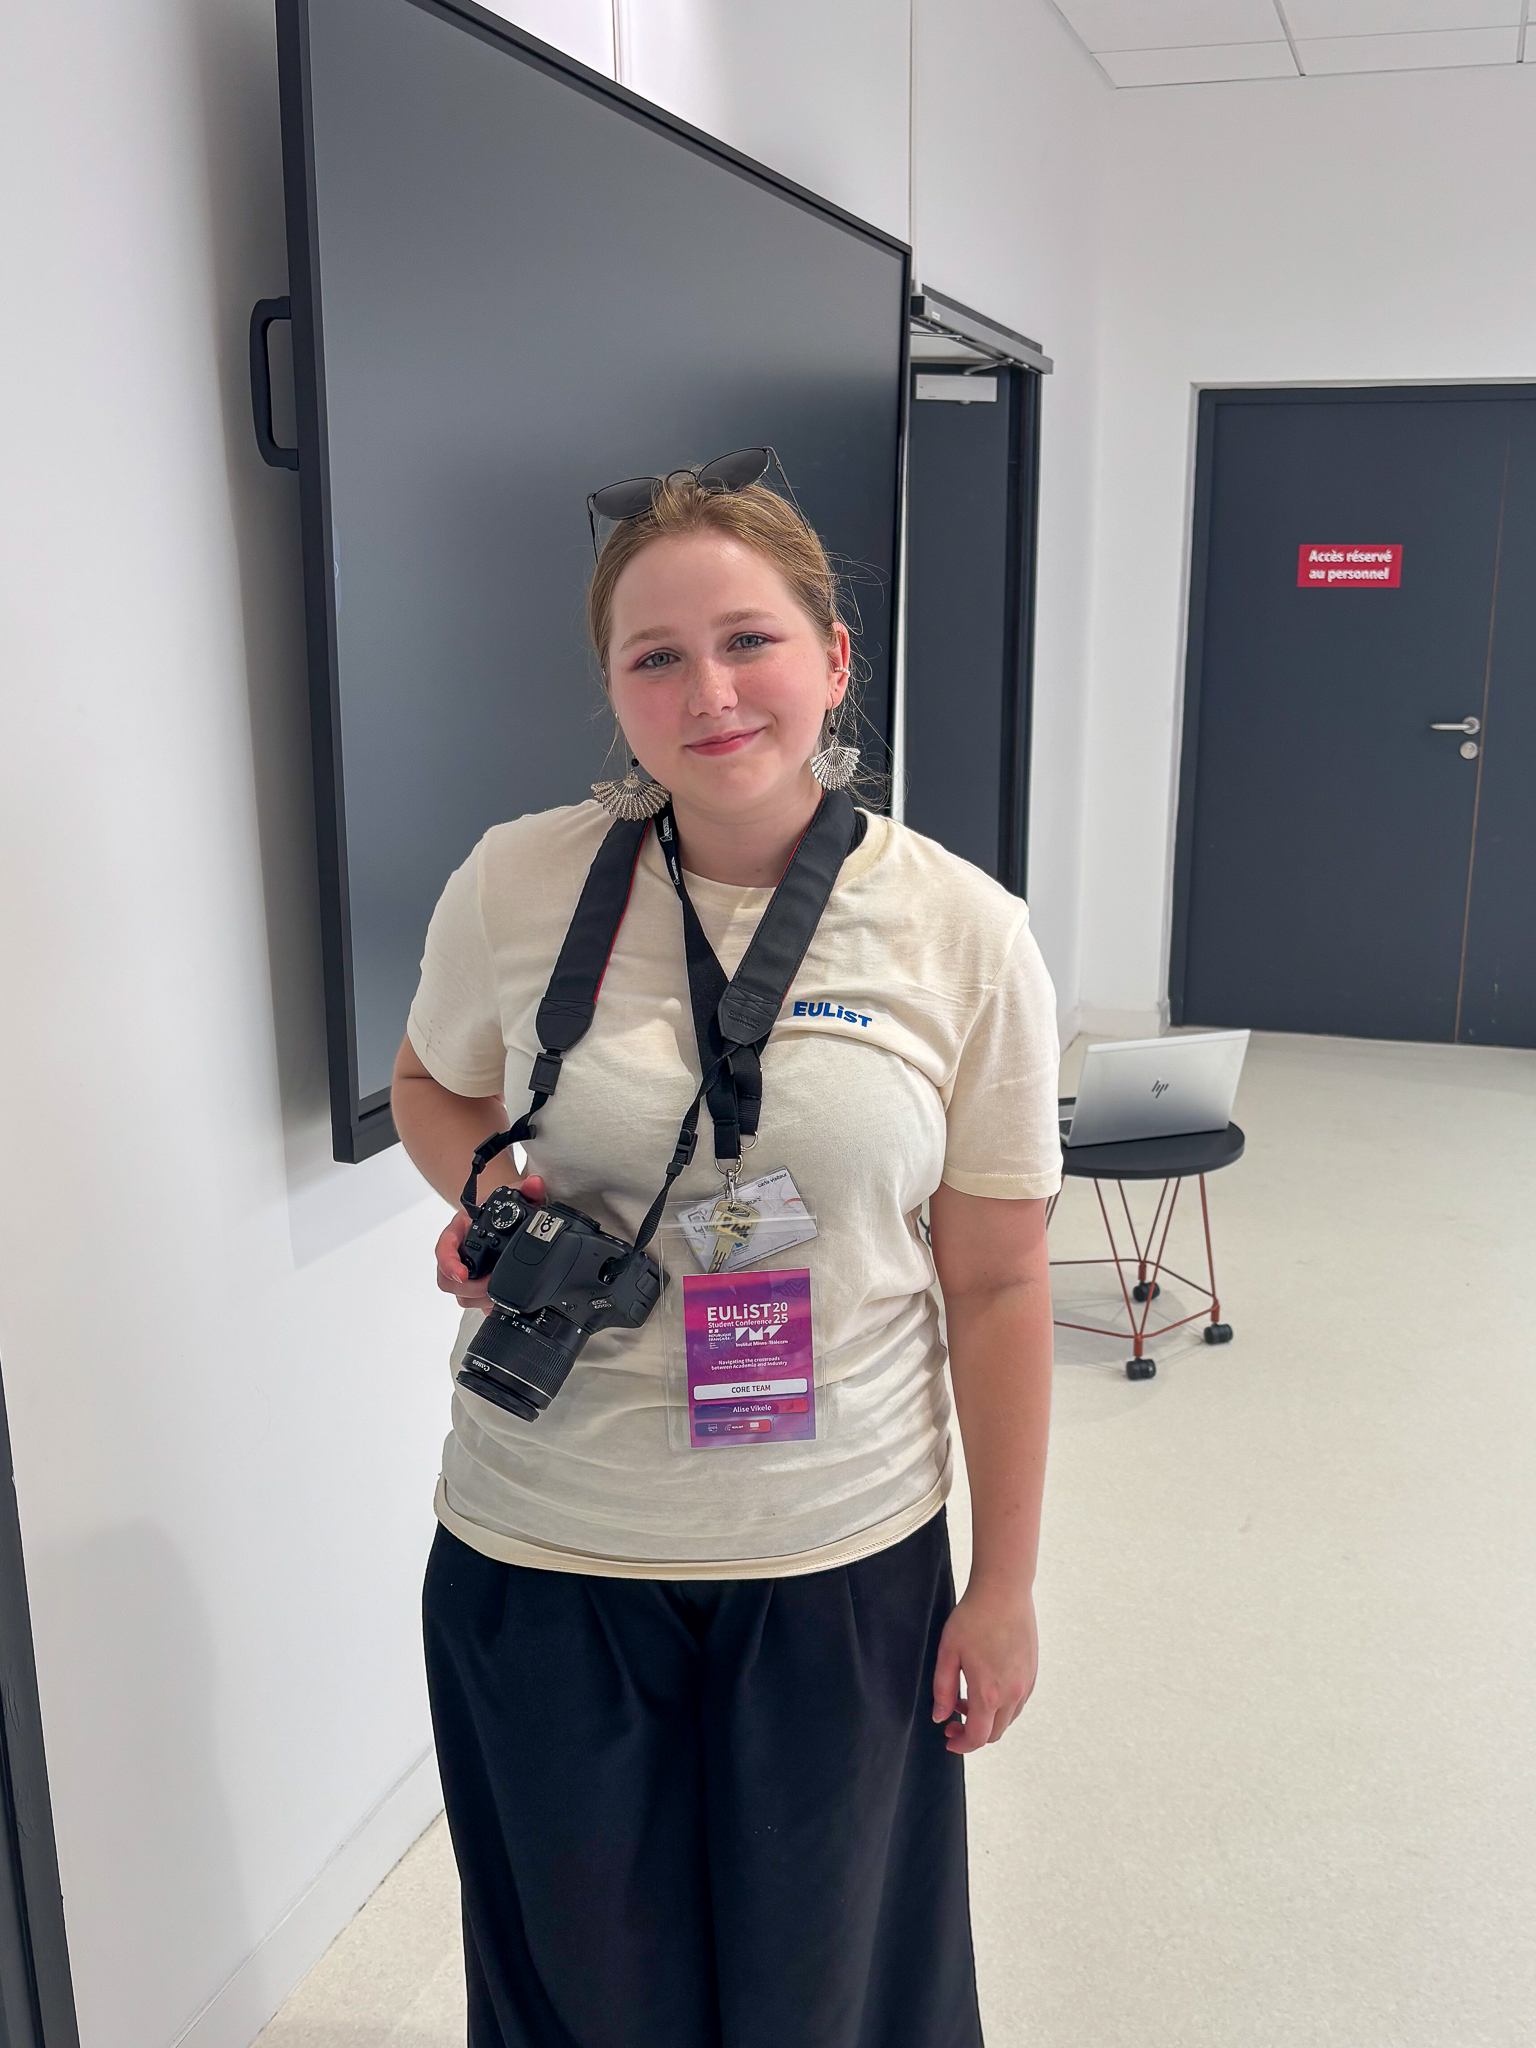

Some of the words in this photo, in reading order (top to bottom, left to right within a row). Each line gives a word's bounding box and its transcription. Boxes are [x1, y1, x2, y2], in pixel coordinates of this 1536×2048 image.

[1308, 549, 1344, 563] Accès
[1346, 549, 1393, 563] réservé
[1308, 568, 1326, 580] au
[1327, 567, 1390, 583] personnel
[707, 1303, 771, 1322] EULiST
[773, 1301, 788, 1313] 20
[735, 1319, 772, 1327] Conference
[773, 1313, 788, 1324] 25
[472, 1359, 491, 1372] Canon
